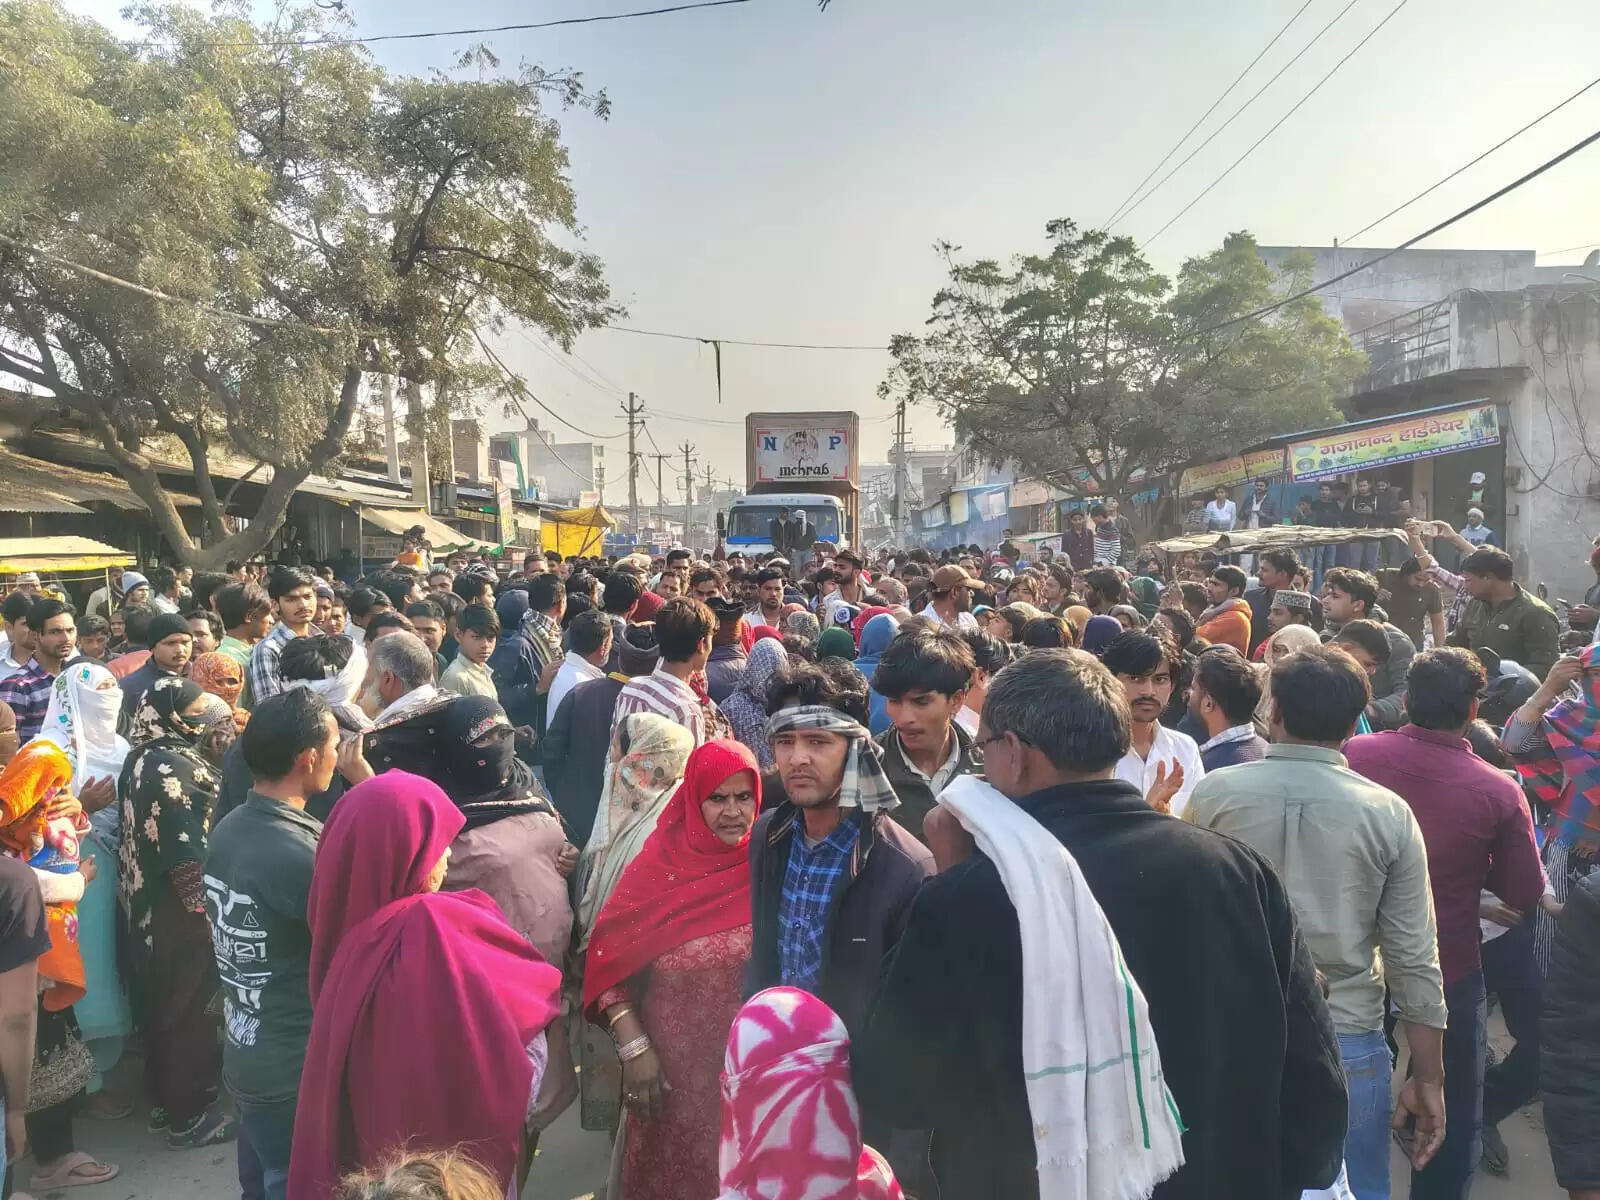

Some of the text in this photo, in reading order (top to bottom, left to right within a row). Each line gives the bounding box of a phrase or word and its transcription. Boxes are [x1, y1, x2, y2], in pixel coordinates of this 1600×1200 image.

[763, 436, 842, 451] N P
[1320, 433, 1393, 455] गजानन्द
